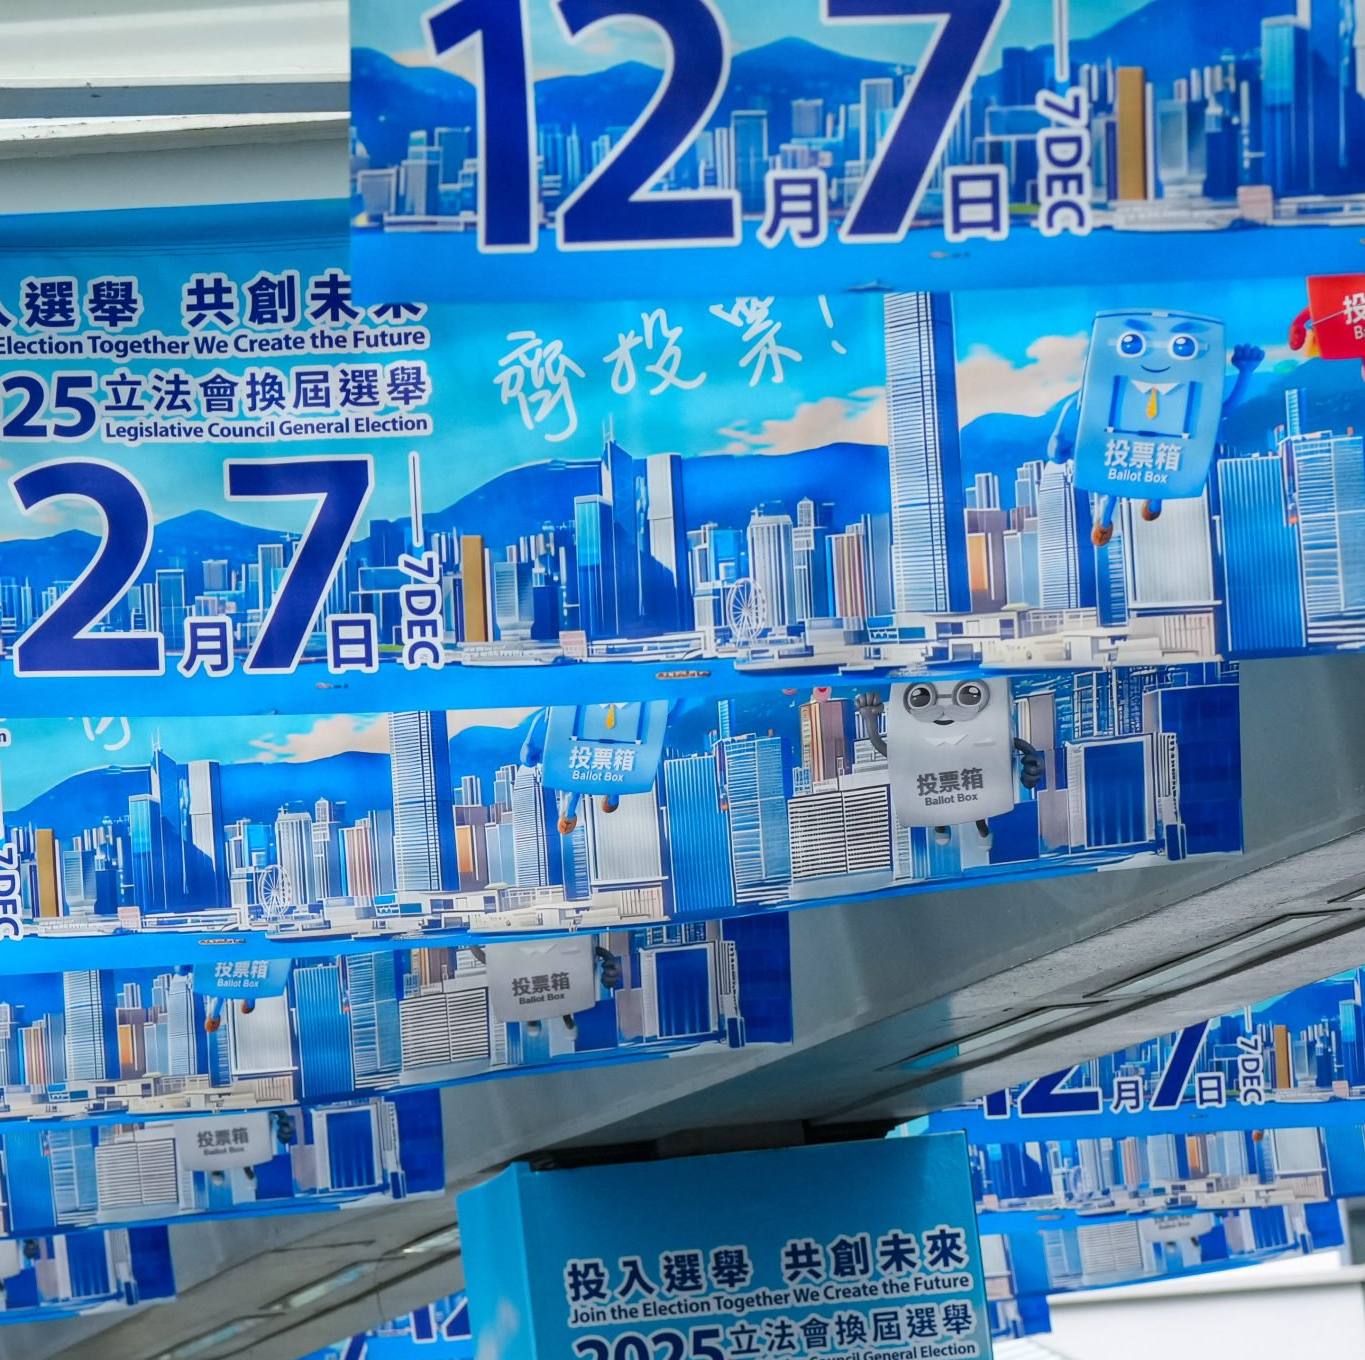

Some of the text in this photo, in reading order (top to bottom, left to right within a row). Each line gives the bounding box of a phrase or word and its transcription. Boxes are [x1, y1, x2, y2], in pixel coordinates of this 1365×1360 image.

[436, 0, 1002, 246] 12月7日
[88, 334, 190, 358] Together
[194, 335, 229, 354] We
[235, 333, 305, 353] Create
[310, 330, 348, 349] the
[353, 329, 426, 349] Future
[105, 415, 428, 441] Legislative Council General Election
[1104, 439, 1181, 472] 投票箱
[1107, 469, 1168, 484] Ballot Box
[568, 744, 637, 773] 投票箱
[572, 769, 624, 784] Ballot Box
[916, 766, 985, 797] 投票箱
[925, 790, 979, 806] Ballot Box
[512, 971, 572, 996] 投票箱
[197, 1127, 249, 1149] 投票箱
[568, 1229, 966, 1301] 投入選舉 共創未來
[571, 1273, 970, 1325] Join the Election Together We Create the Future
[920, 1342, 976, 1359] Election
